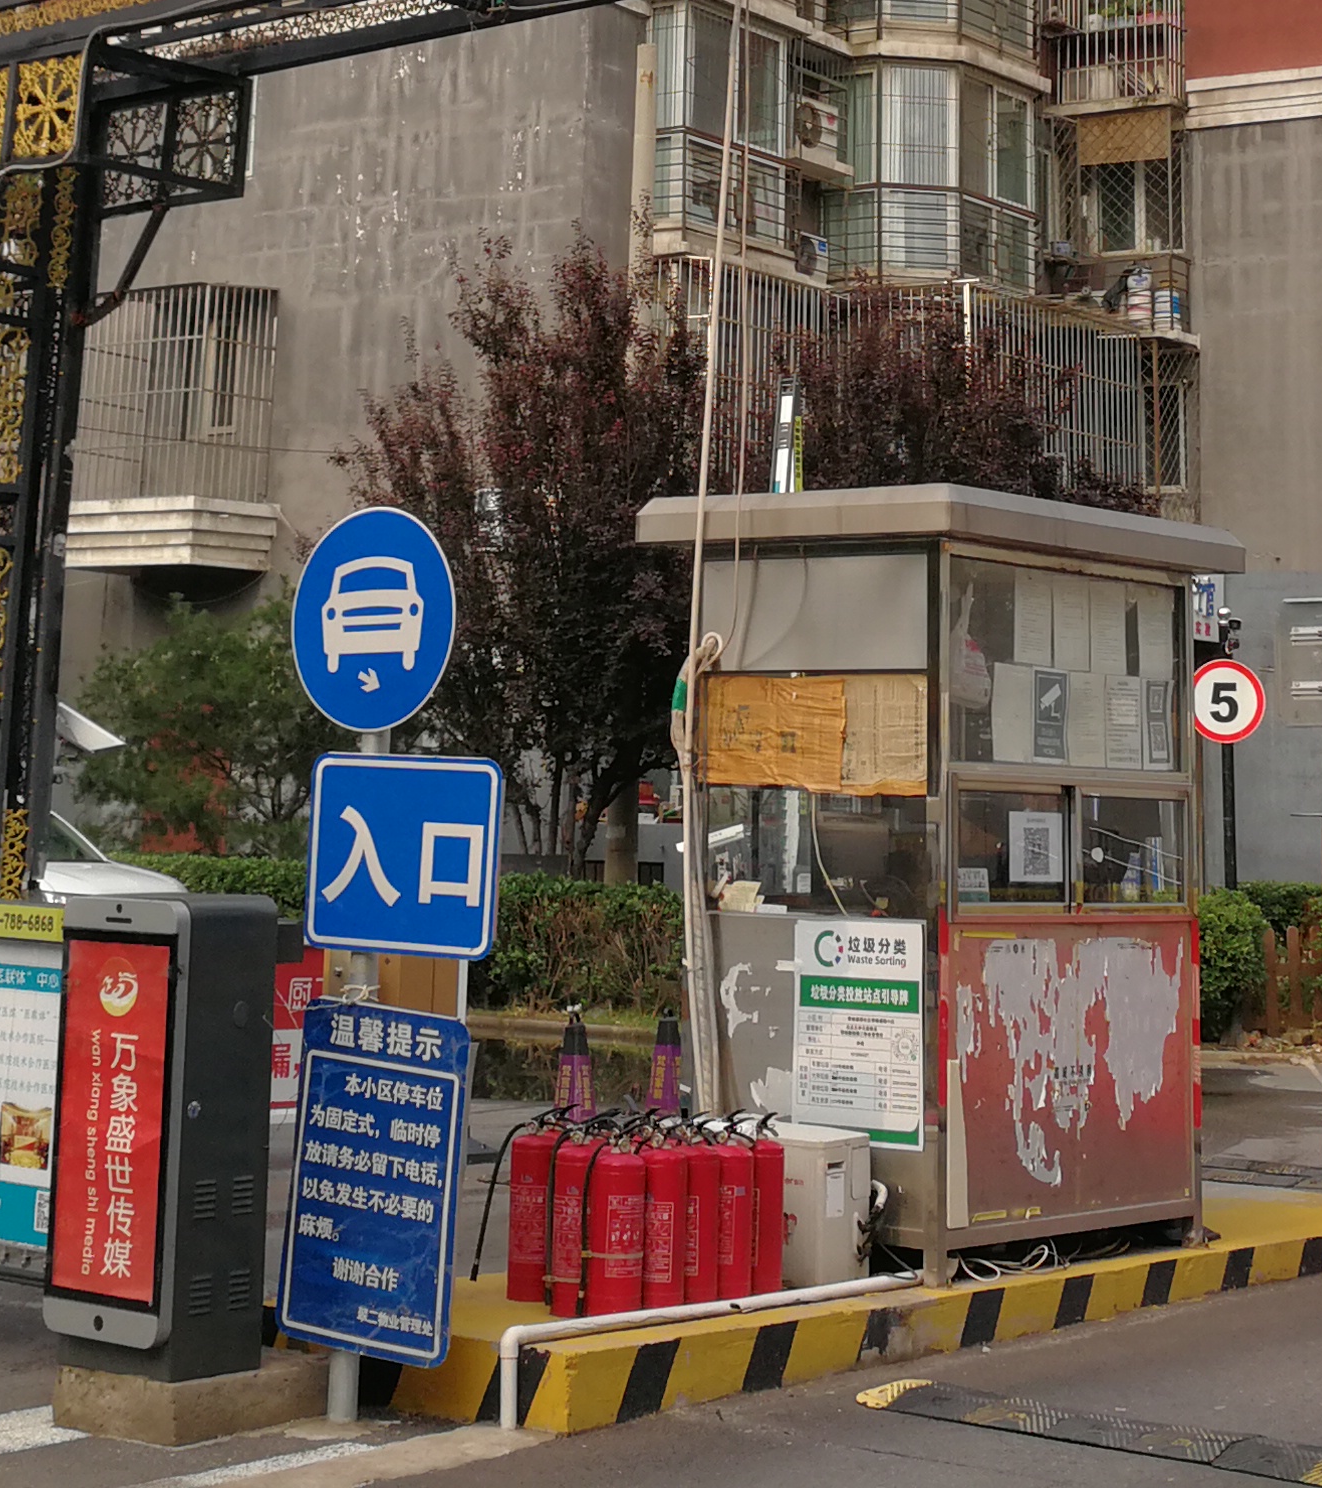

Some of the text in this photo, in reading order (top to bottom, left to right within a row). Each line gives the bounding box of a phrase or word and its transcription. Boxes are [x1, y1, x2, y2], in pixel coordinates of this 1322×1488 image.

[1209, 682, 1239, 723] 5
[321, 804, 483, 908] 入口
[847, 954, 906, 968] Waste Sorting
[848, 936, 906, 955] 垃圾分类
[90, 1028, 102, 1067] wan
[329, 1013, 443, 1061] 温馨提示
[86, 1073, 102, 1121] xiang
[344, 1073, 444, 1111] 本小区停车位
[85, 1125, 99, 1181] sheng
[99, 1031, 139, 1280] 万象盛世传媒
[301, 1177, 434, 1223] 以免发生不必要的
[80, 1217, 96, 1276] media
[298, 1213, 339, 1242] 麻烦。
[332, 1256, 400, 1292] 谢谢合作
